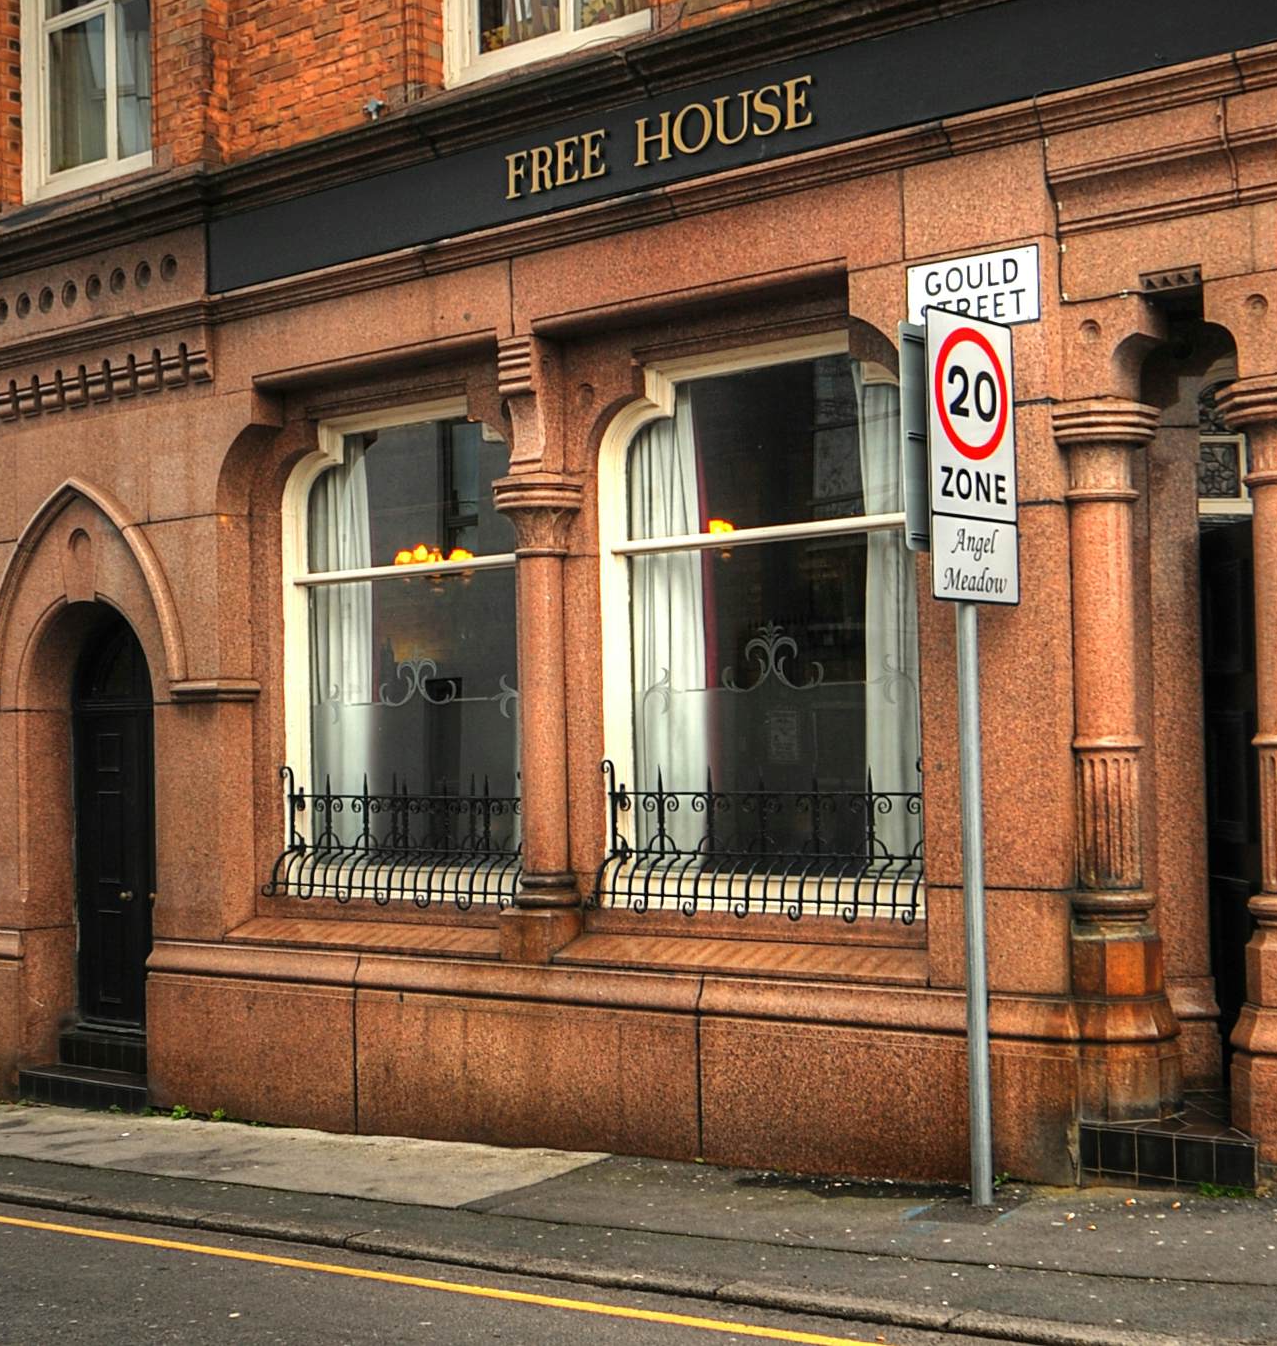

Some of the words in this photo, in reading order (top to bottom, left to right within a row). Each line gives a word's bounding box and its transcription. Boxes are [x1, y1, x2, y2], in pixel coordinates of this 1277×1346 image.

[505, 129, 607, 201] FREE
[634, 75, 813, 167] HOUSE
[924, 257, 1019, 296] GOULD
[921, 288, 1026, 321] TREET
[947, 364, 997, 422] 20
[940, 465, 1008, 504] ZONE
[951, 528, 1000, 561] Angel
[943, 567, 1007, 595] Meadow
